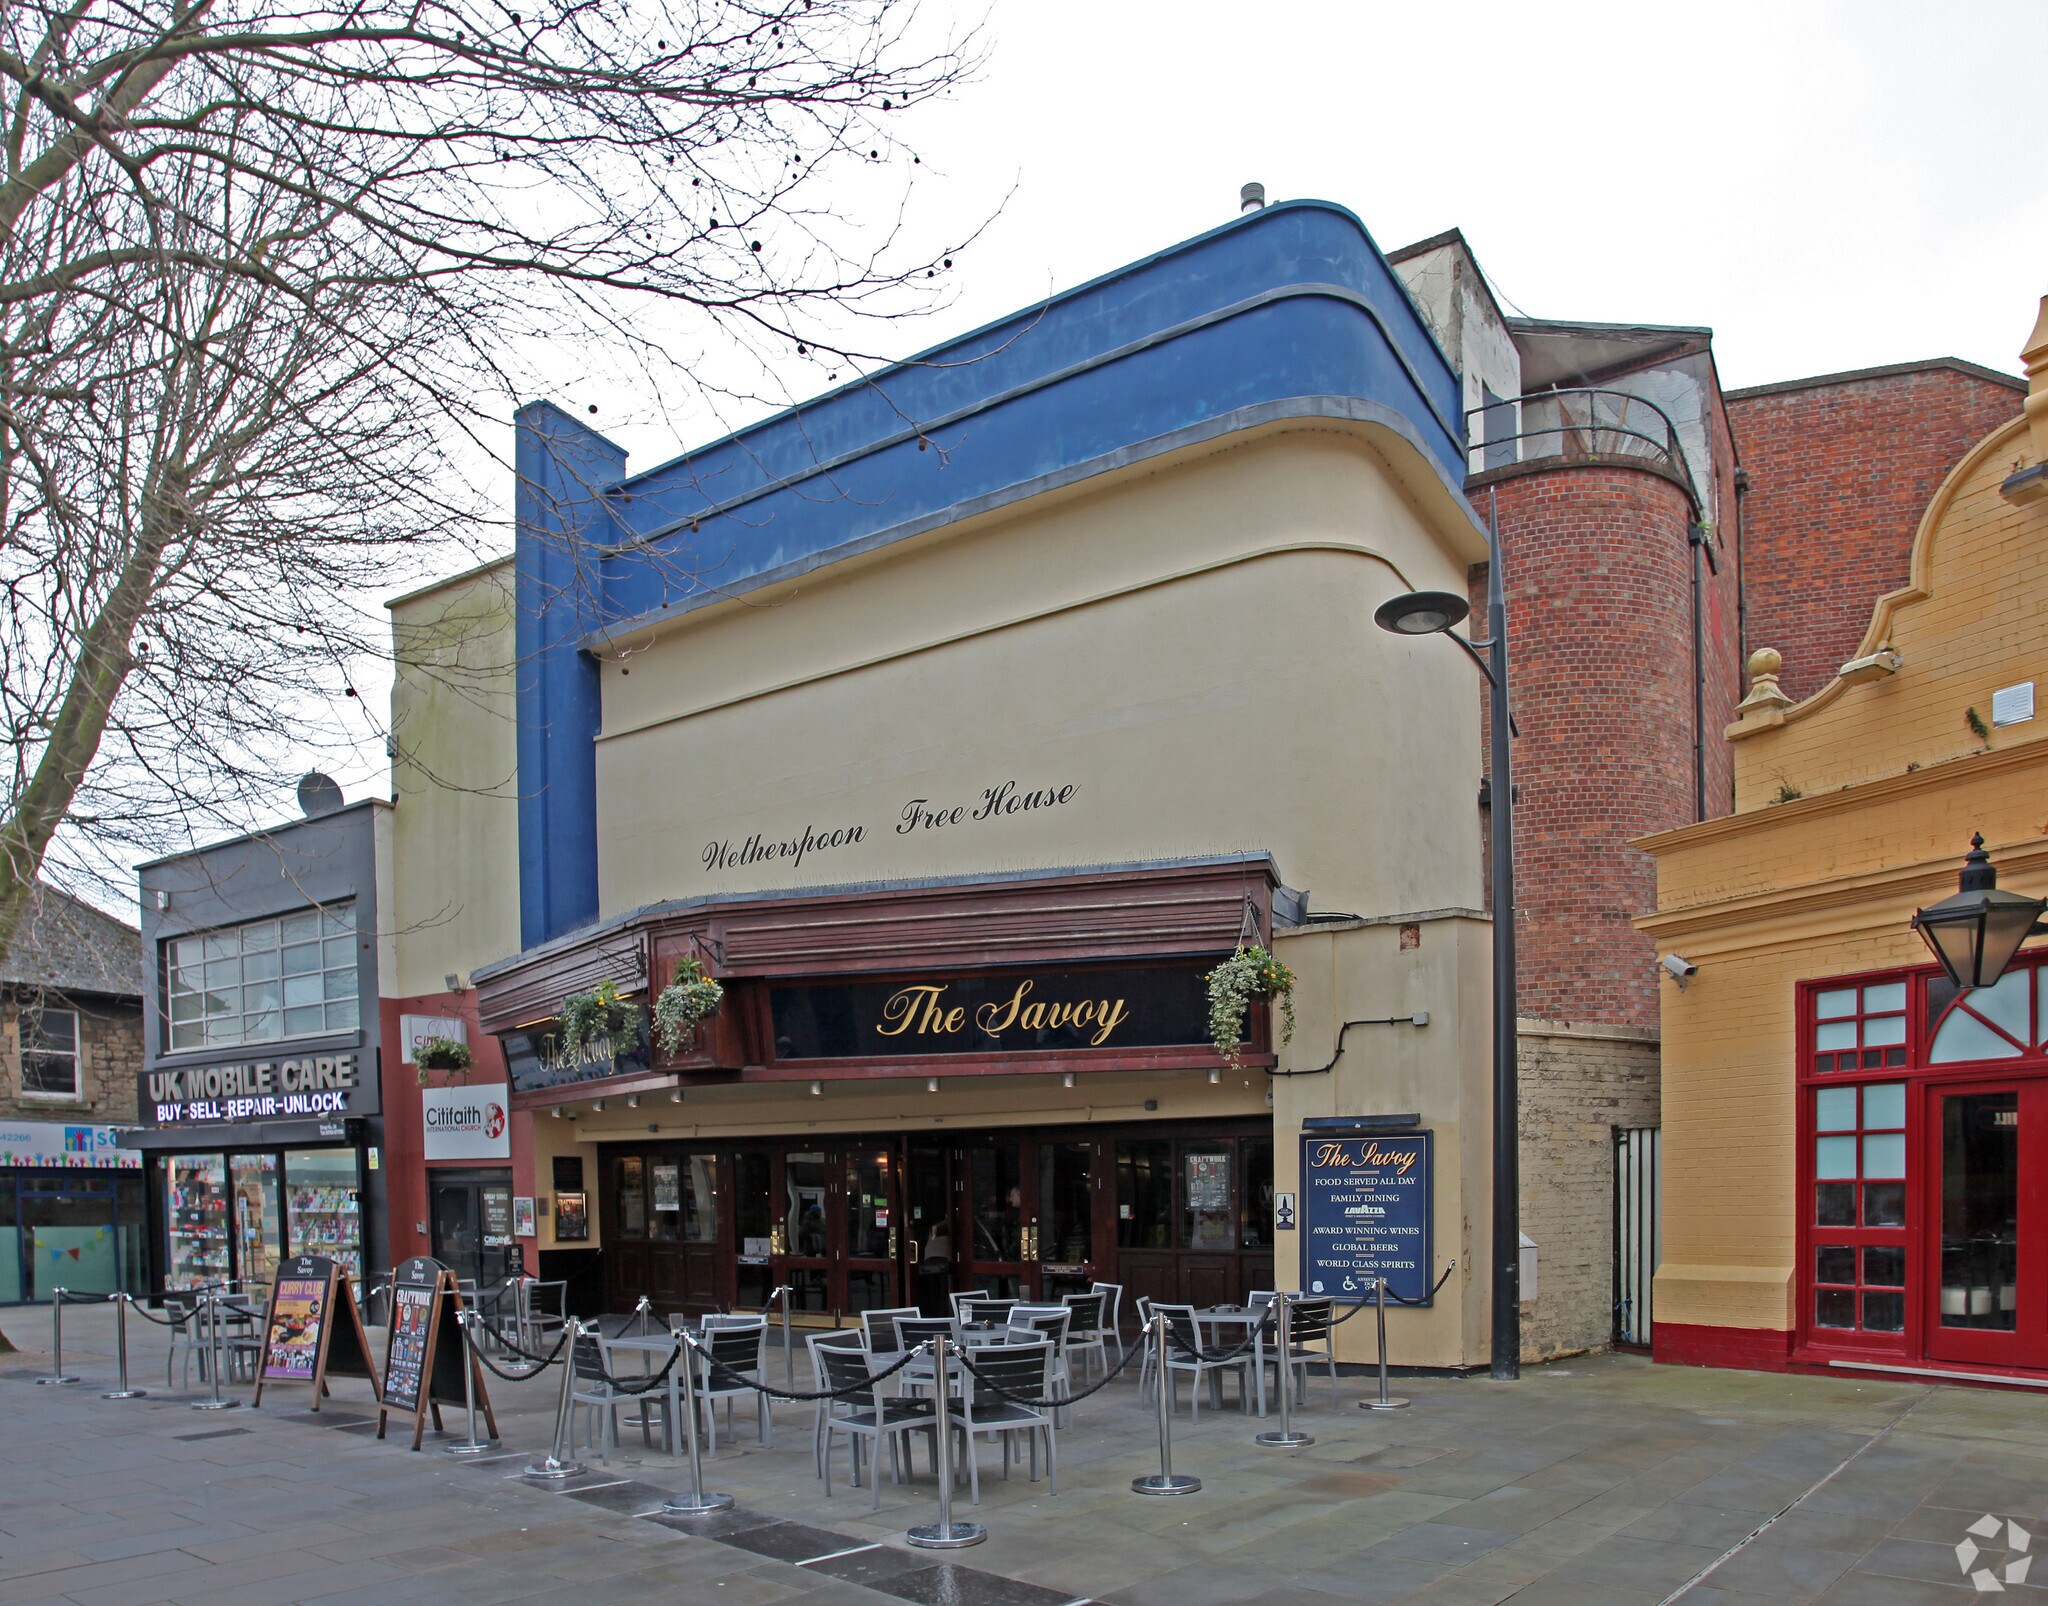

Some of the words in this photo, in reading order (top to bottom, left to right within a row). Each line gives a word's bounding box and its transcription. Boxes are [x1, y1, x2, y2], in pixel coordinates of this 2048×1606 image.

[701, 825, 869, 872] Wetherspoon
[896, 799, 971, 835] Free
[973, 780, 1082, 820] House
[876, 984, 965, 1036] The
[975, 979, 1130, 1046] Savoy
[149, 1071, 183, 1101] UK
[187, 1062, 272, 1099] MOBILE
[281, 1054, 353, 1092] CARE
[426, 1106, 481, 1126] Citifaith
[1311, 1143, 1350, 1168] The
[1352, 1142, 1417, 1175] Savoy
[1315, 1178, 1341, 1186] FOOD
[1343, 1177, 1378, 1186] SERVED
[1379, 1177, 1396, 1185] ALL
[1398, 1177, 1416, 1185] DAY
[1330, 1194, 1362, 1202] FAMILY
[1364, 1194, 1400, 1202] DINING
[1313, 1227, 1343, 1235] AWARD
[1345, 1227, 1387, 1235] WINNING
[1389, 1227, 1419, 1235] WINES
[1332, 1243, 1368, 1251] GLOBAL
[1370, 1243, 1398, 1252] BEERS
[301, 1257, 312, 1265] The
[414, 1260, 424, 1270] The
[1316, 1260, 1350, 1268] WORLD
[1352, 1260, 1379, 1268] CLASS
[1381, 1260, 1415, 1269] SPIRITS
[297, 1266, 314, 1276] Savoy
[411, 1271, 425, 1283] Savoy
[280, 1280, 304, 1295] CURRY
[304, 1280, 324, 1295] CLUB
[396, 1289, 432, 1306] CRAFTWORK
